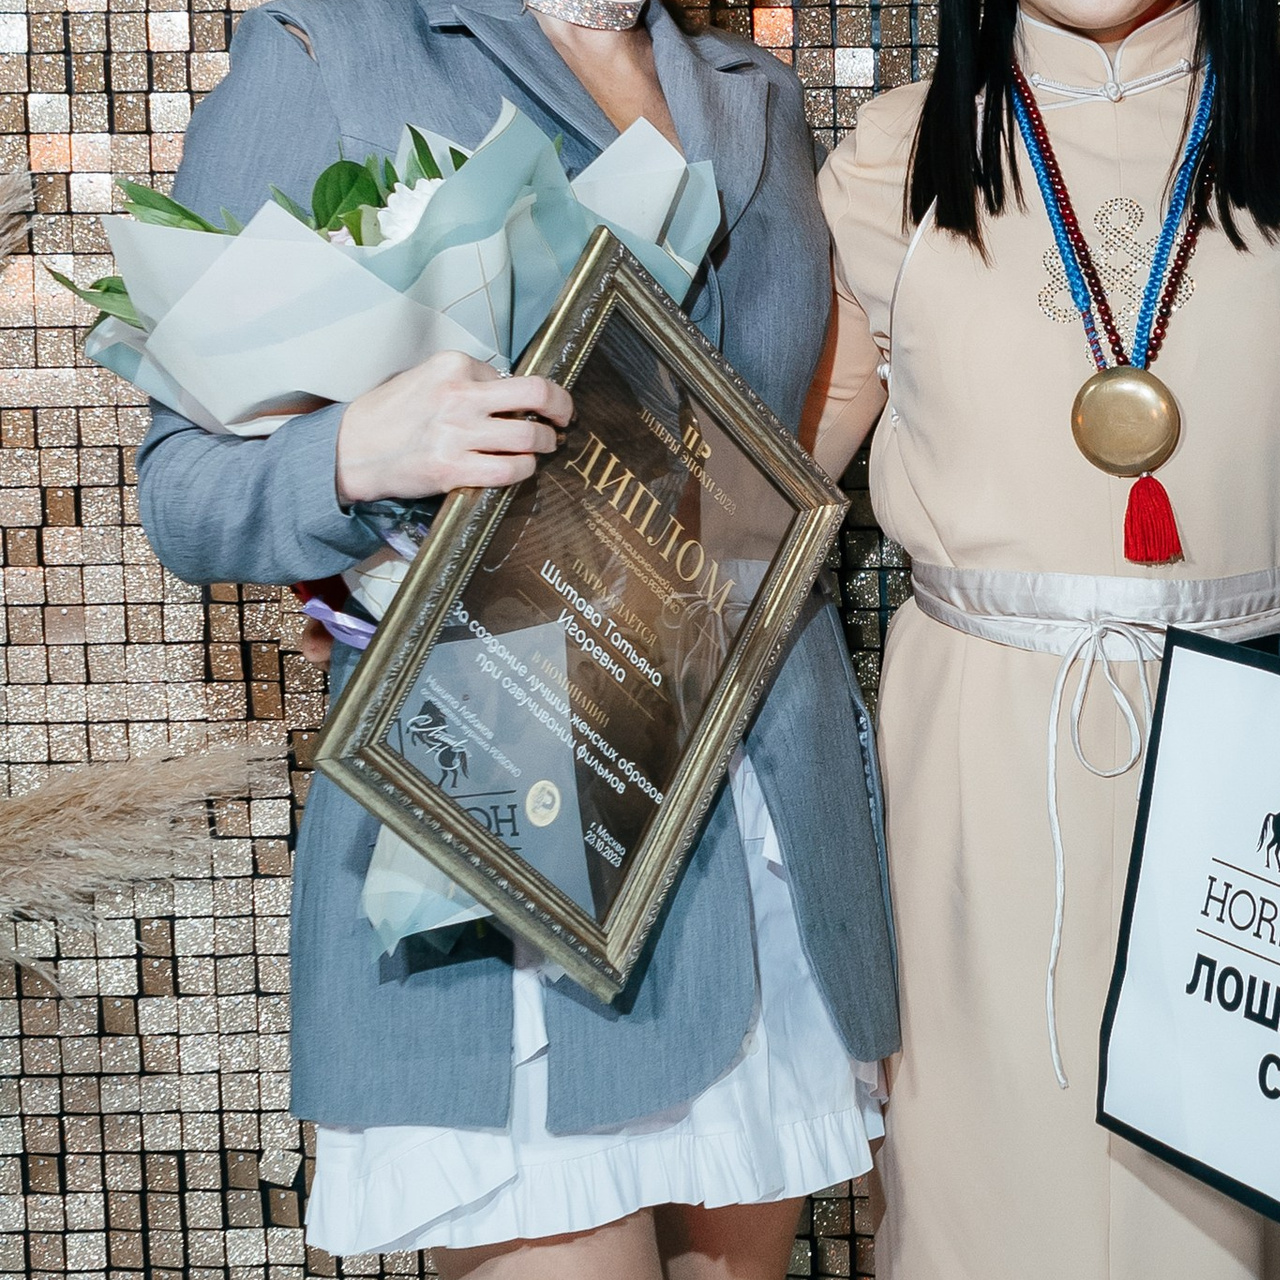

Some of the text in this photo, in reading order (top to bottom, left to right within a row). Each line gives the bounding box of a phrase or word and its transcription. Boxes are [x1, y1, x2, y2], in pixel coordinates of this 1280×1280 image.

[635, 402, 737, 517] ЛИДЕРЫ ЭПОХИ 2023
[564, 431, 736, 615] ДИПЛОМ
[539, 557, 665, 688] Шитова Татьяна
[555, 606, 629, 686] Игоревна
[450, 597, 472, 625] За
[466, 617, 528, 681] создание
[524, 671, 572, 722] лучших
[569, 712, 619, 763] женских
[614, 752, 666, 809] образов
[473, 650, 502, 684] при
[498, 674, 578, 753] озвучивании
[573, 740, 628, 798] фильмов
[583, 828, 623, 869] 23.10.2023
[596, 824, 627, 857] Москва
